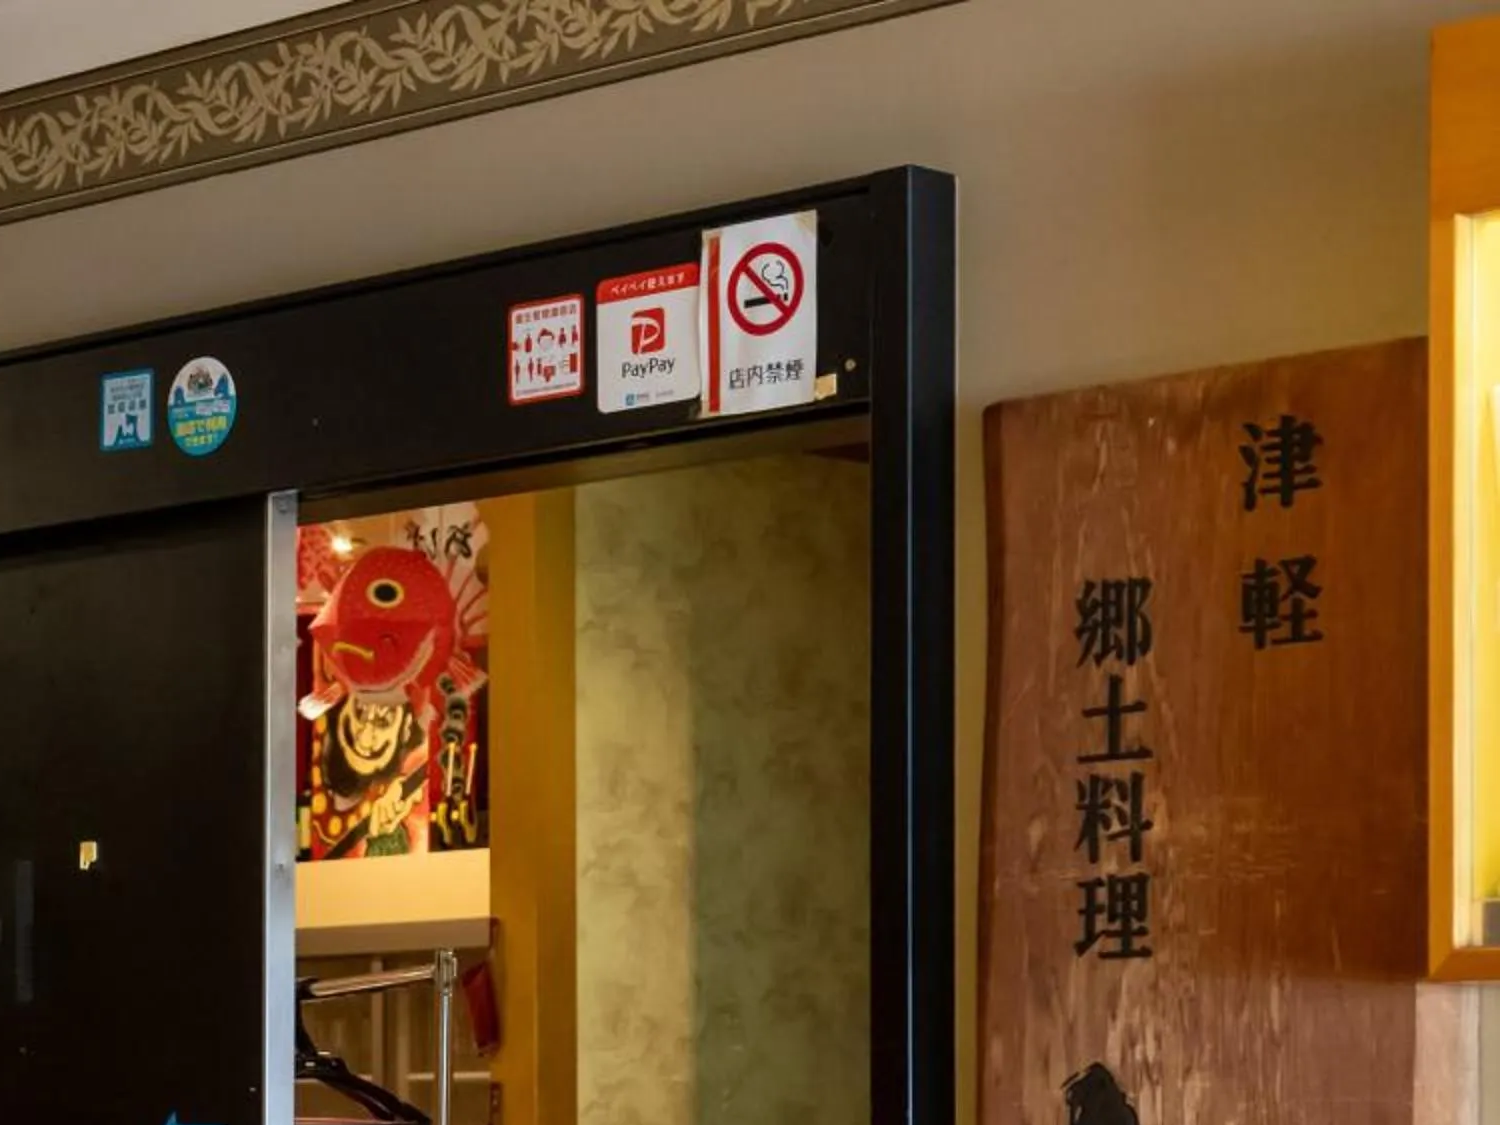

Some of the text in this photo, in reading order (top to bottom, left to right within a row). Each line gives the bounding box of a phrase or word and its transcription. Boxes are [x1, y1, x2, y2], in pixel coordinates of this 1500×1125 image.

[621, 356, 675, 379] PayPay
[728, 358, 805, 390] 店内禁煙
[1238, 414, 1324, 651] 津軽
[1072, 576, 1155, 962] 郷土料理
